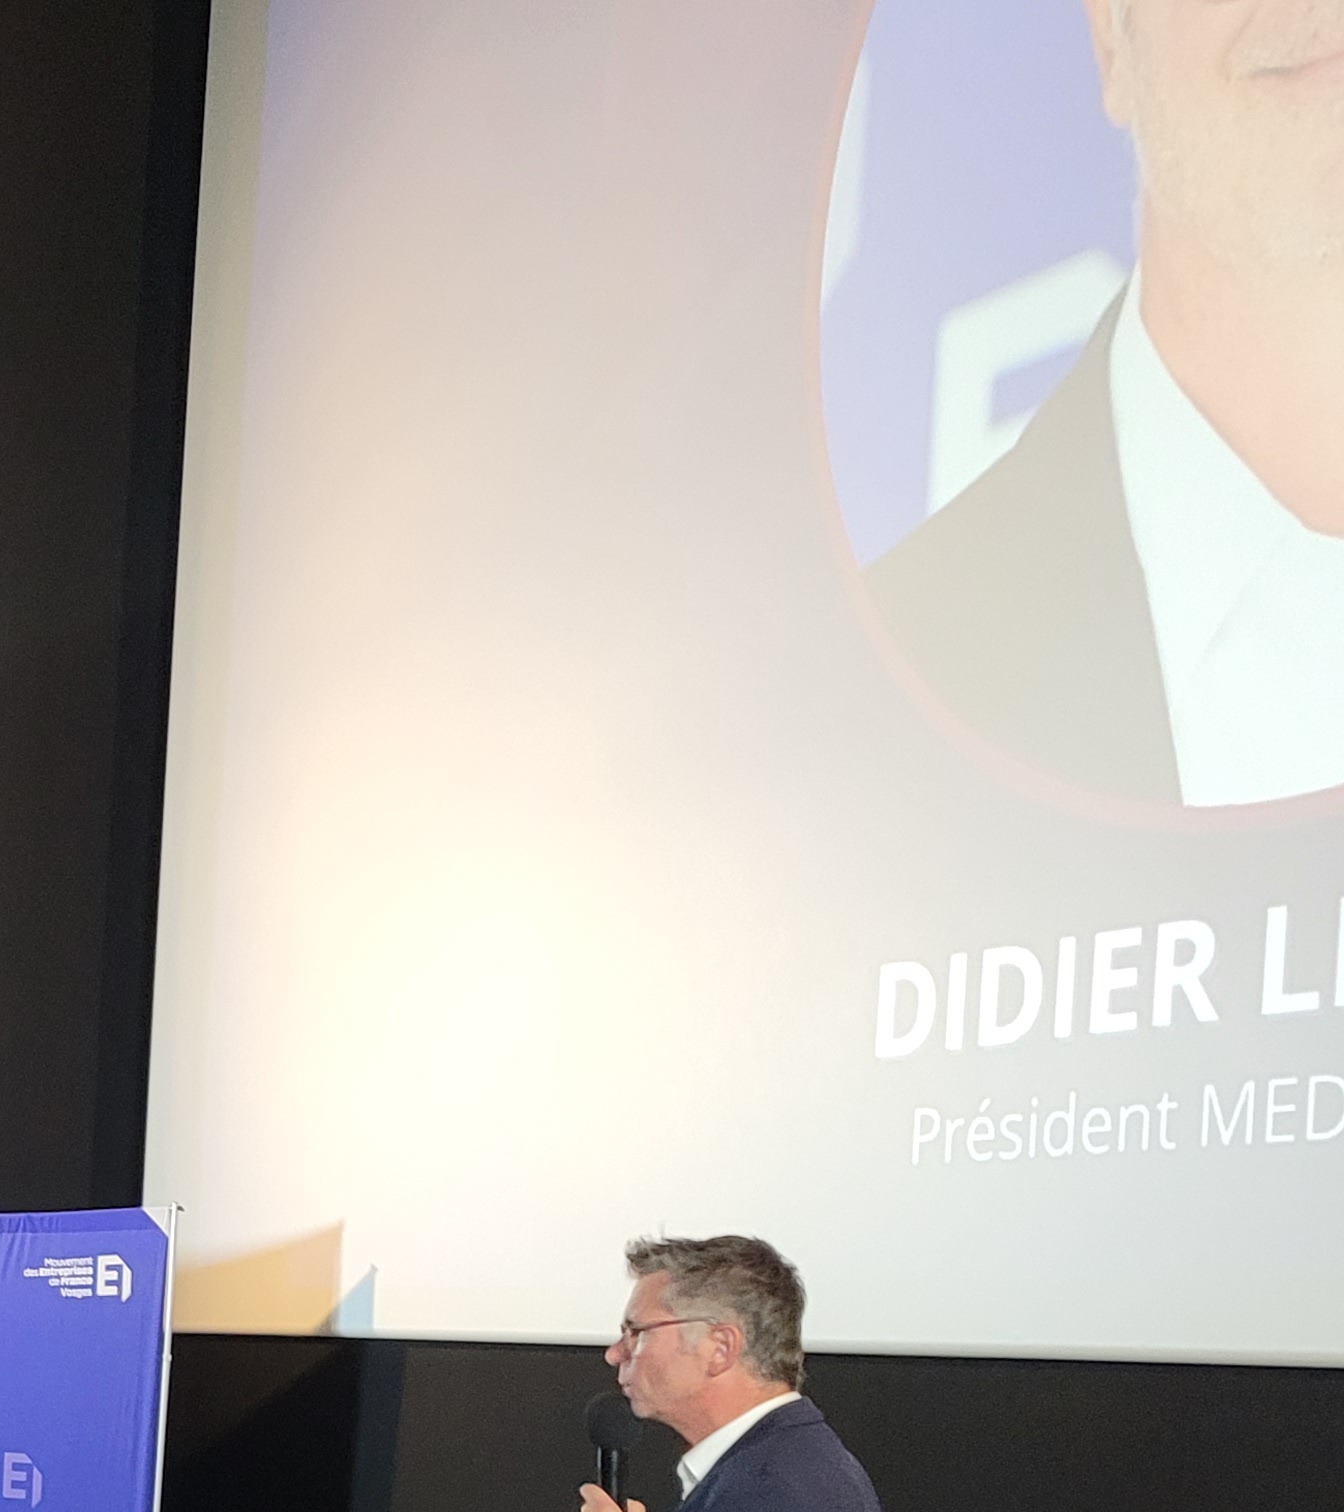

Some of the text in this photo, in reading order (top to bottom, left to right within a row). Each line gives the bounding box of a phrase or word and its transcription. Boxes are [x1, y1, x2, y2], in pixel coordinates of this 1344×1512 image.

[875, 896, 1344, 1059] DIDIER L
[912, 1074, 1344, 1166] Président MED
